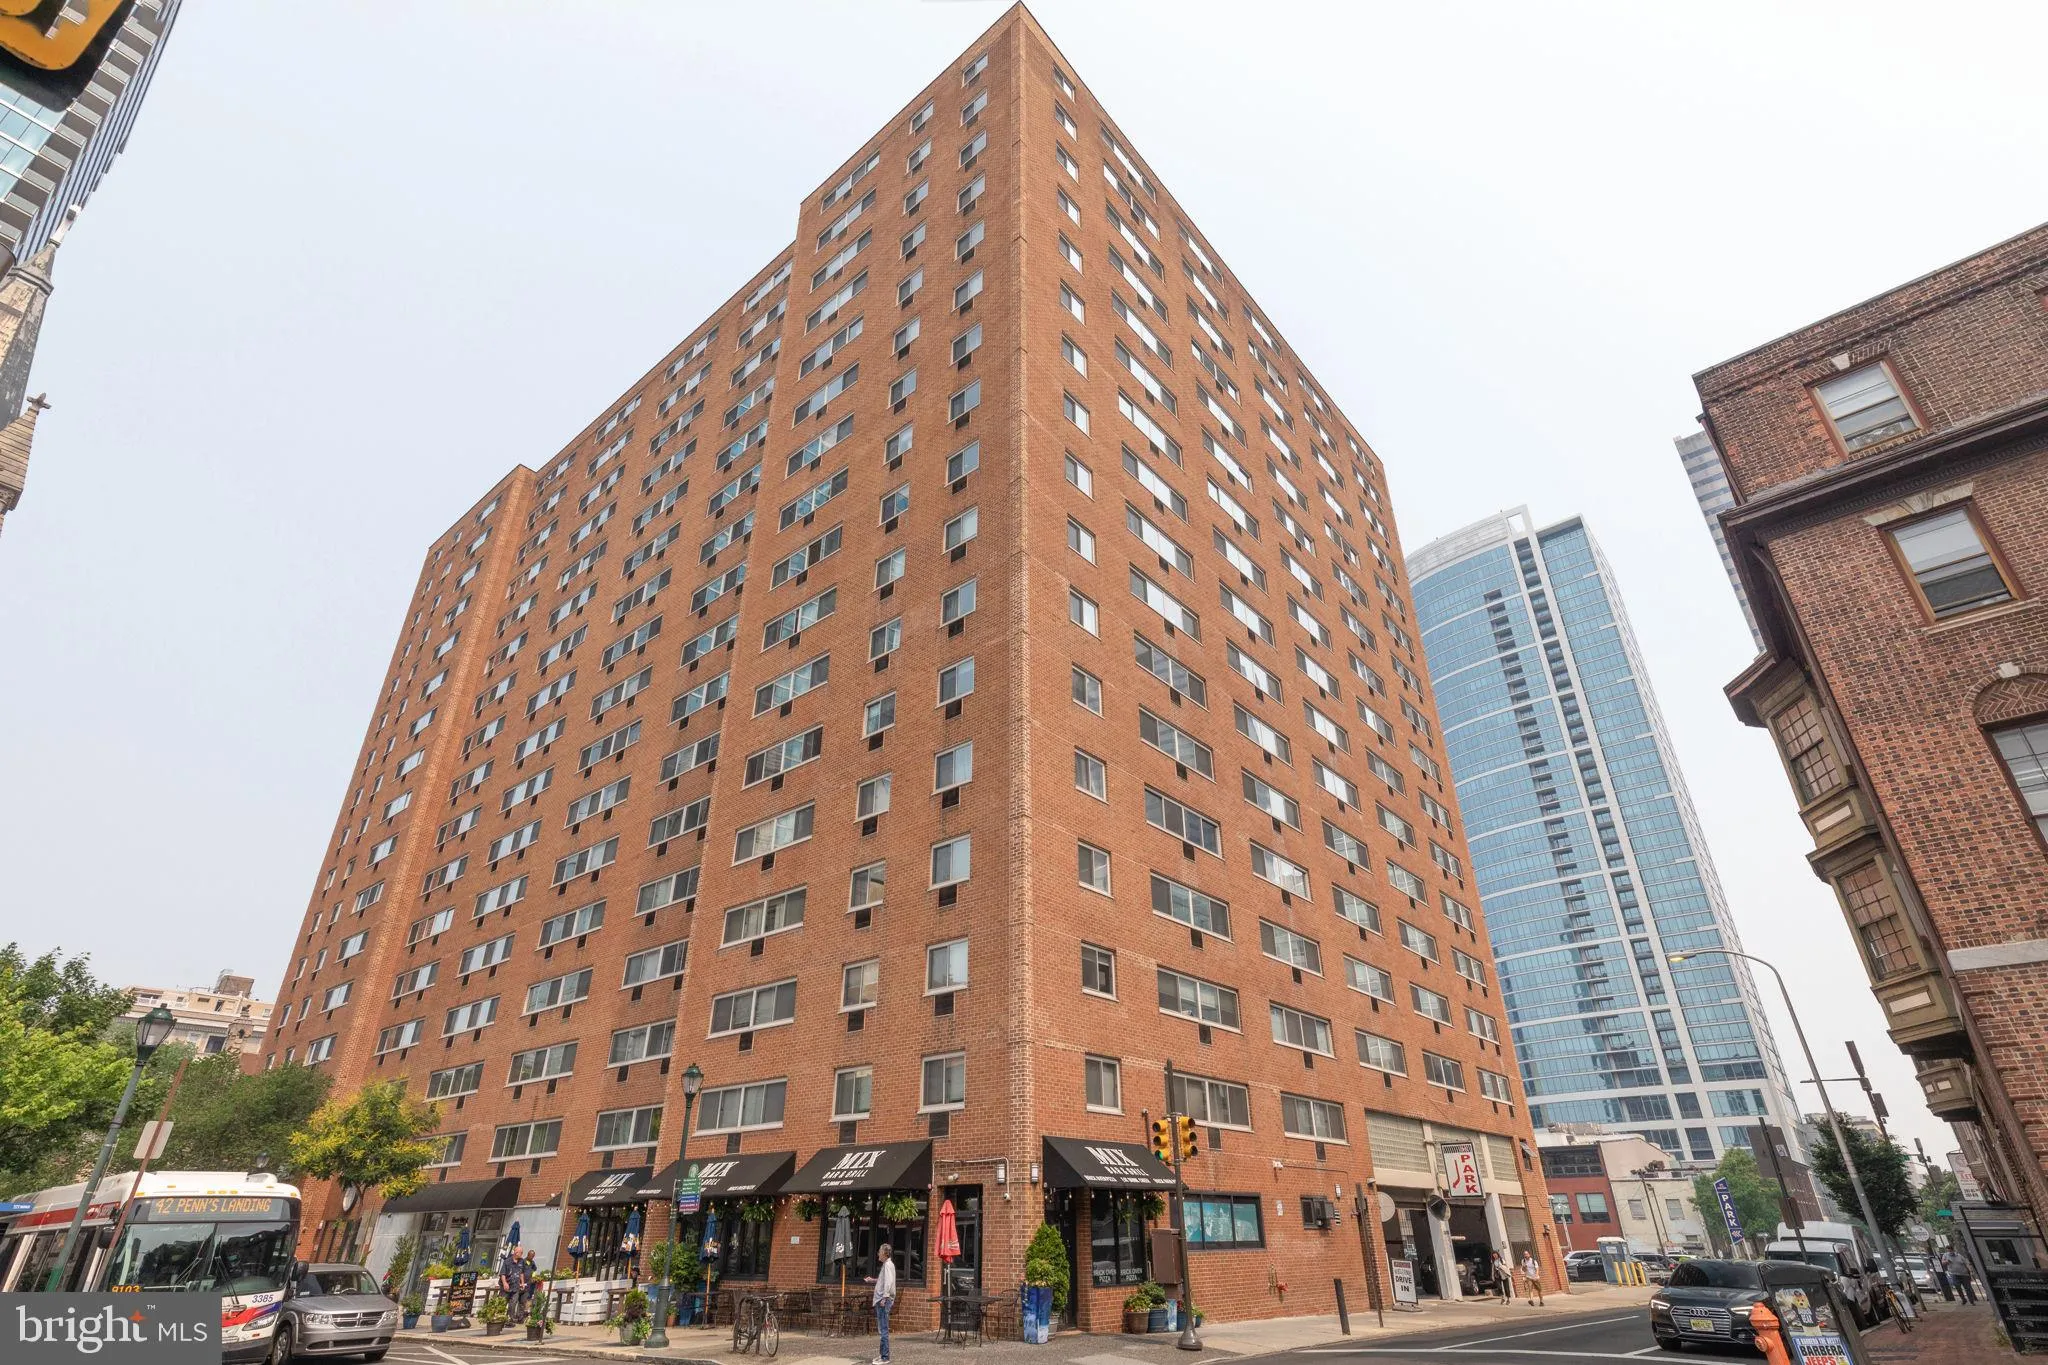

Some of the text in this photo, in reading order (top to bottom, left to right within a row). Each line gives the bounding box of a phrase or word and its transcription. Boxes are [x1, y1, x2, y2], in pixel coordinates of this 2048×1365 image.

[831, 1150, 887, 1170] MIX
[1084, 1146, 1139, 1167] MIX
[697, 1161, 740, 1178] MIX
[822, 1171, 841, 1179] BAR
[845, 1169, 869, 1178] GRILL
[1126, 1167, 1150, 1176] GRILL
[1460, 1154, 1479, 1194] PARK
[596, 1172, 636, 1188] MIX
[156, 1198, 272, 1214] 42 PENN'S LANDING
[1721, 1194, 1738, 1227] PARK
[1395, 1275, 1412, 1284] DRIVE
[251, 1294, 274, 1304] 3385
[1800, 1345, 1846, 1356] BARBERA
[1805, 1356, 1837, 1365] JEEPS
